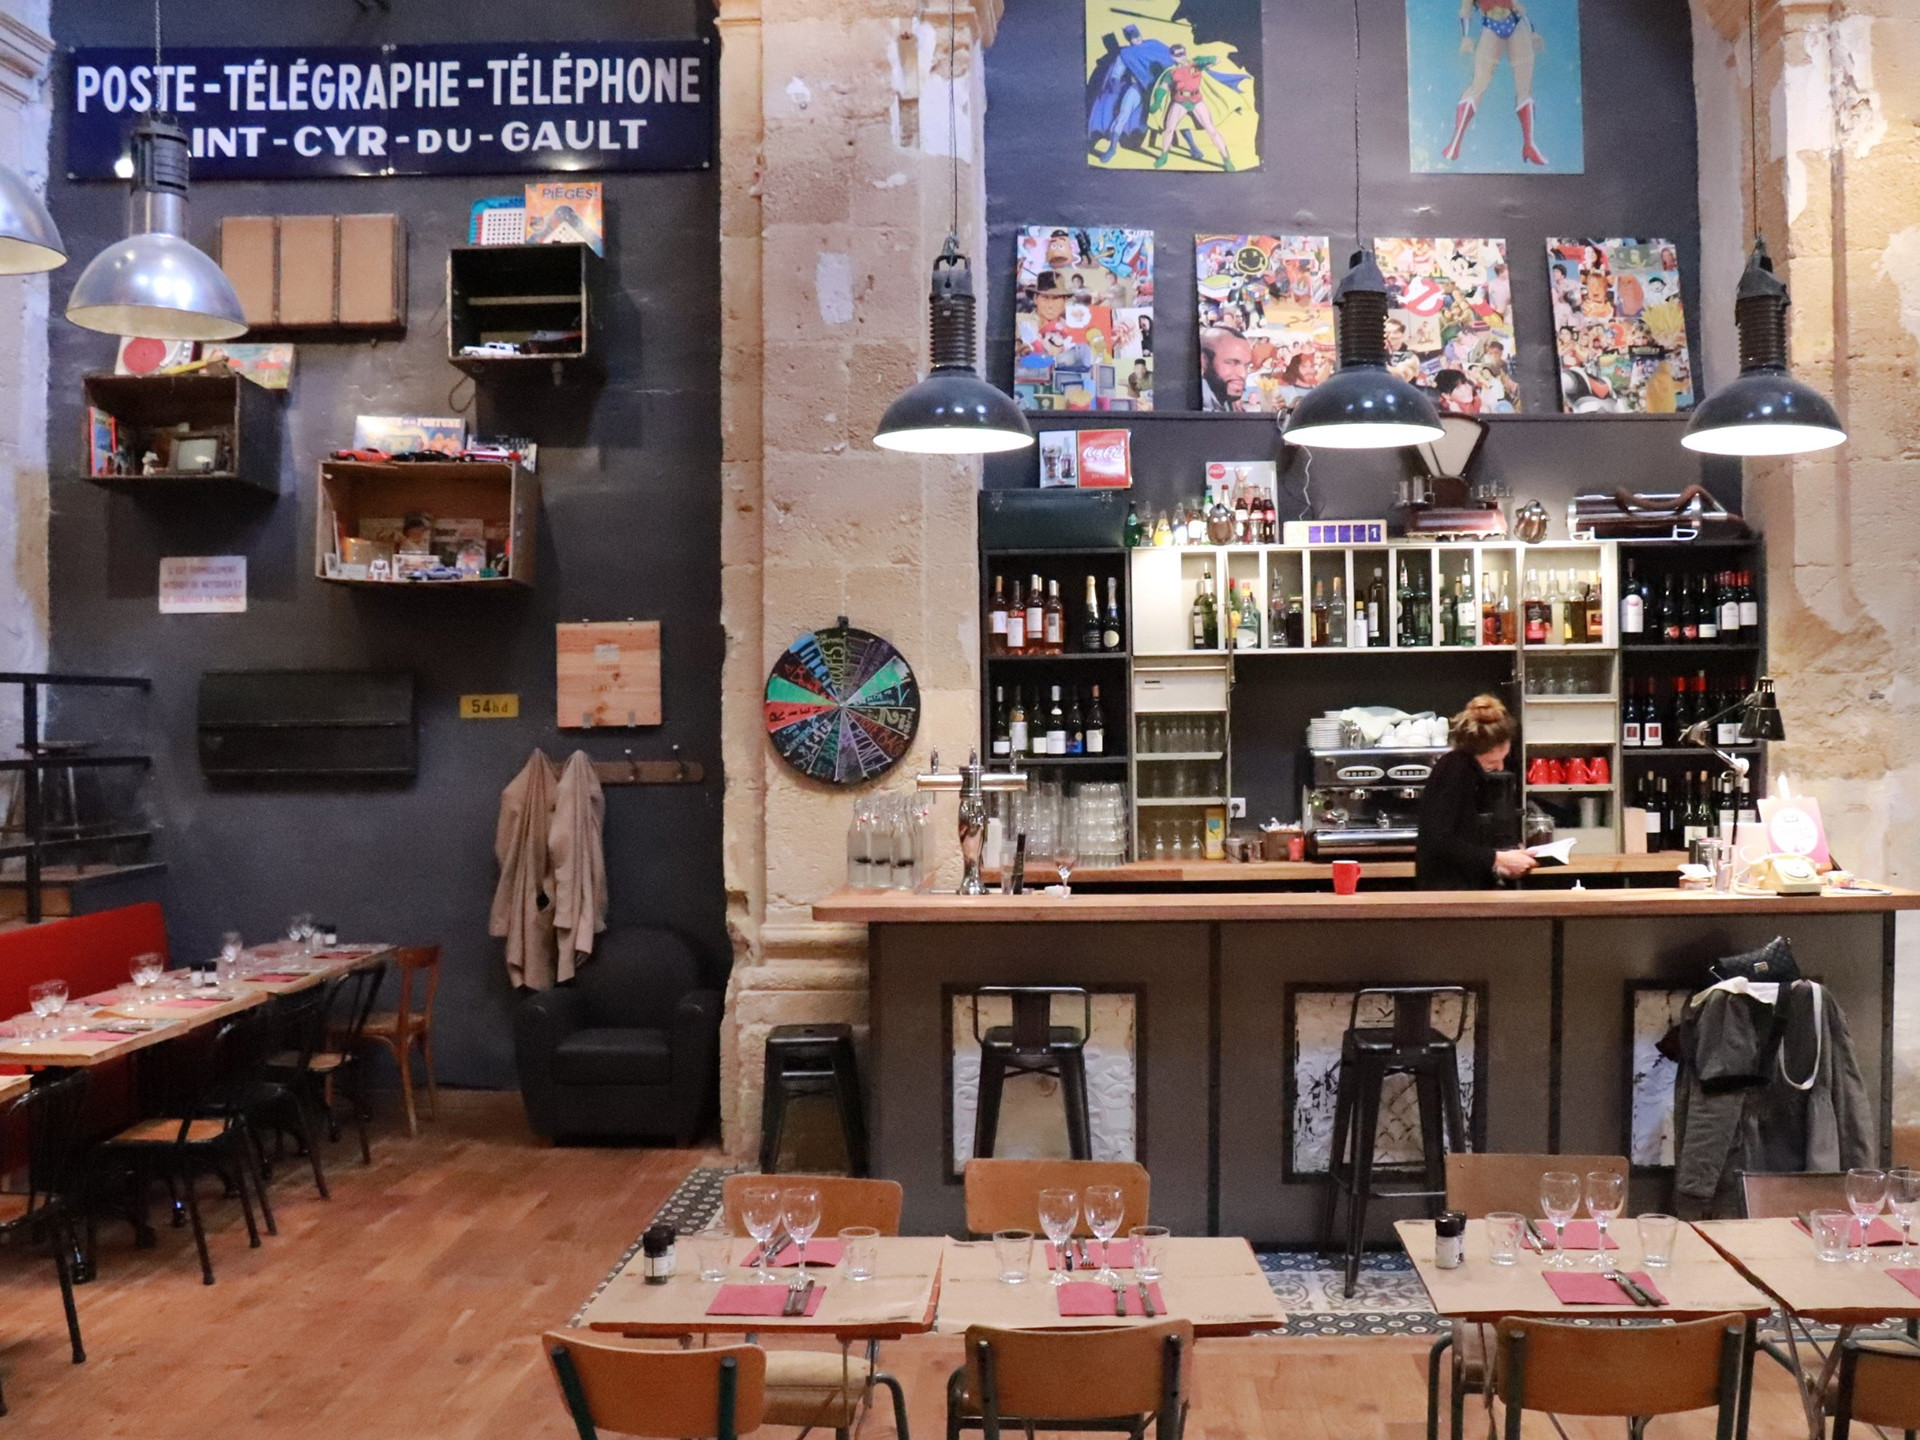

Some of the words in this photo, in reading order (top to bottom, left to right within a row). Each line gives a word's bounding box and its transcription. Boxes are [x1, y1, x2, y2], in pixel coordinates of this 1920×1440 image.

[187, 119, 647, 157] INT-CYR-DU-GAULT
[1371, 528, 1378, 538] 1
[769, 705, 822, 723] RIEN
